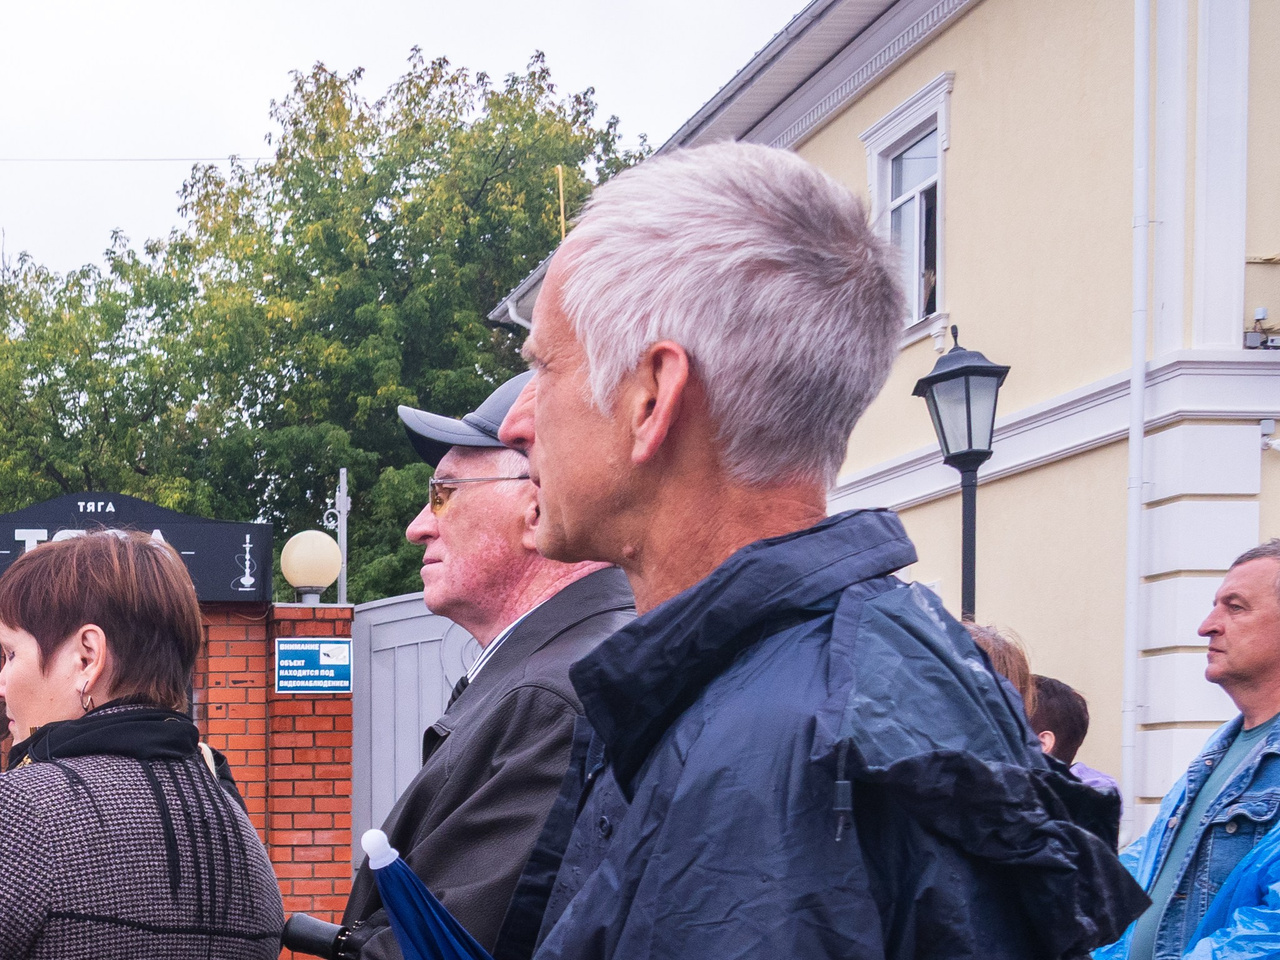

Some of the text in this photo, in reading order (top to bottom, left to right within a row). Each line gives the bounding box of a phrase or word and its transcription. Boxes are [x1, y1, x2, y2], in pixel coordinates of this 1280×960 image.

[78, 502, 116, 513] ТЯГА
[279, 643, 319, 651] ВНИМАНИЕ
[279, 659, 305, 667] ОБЪЕКТ
[279, 669, 335, 677] НАХОДИТСЯ ПОД
[279, 680, 350, 688] ВИДЕОНАБЛЮДЕНИЕМ
